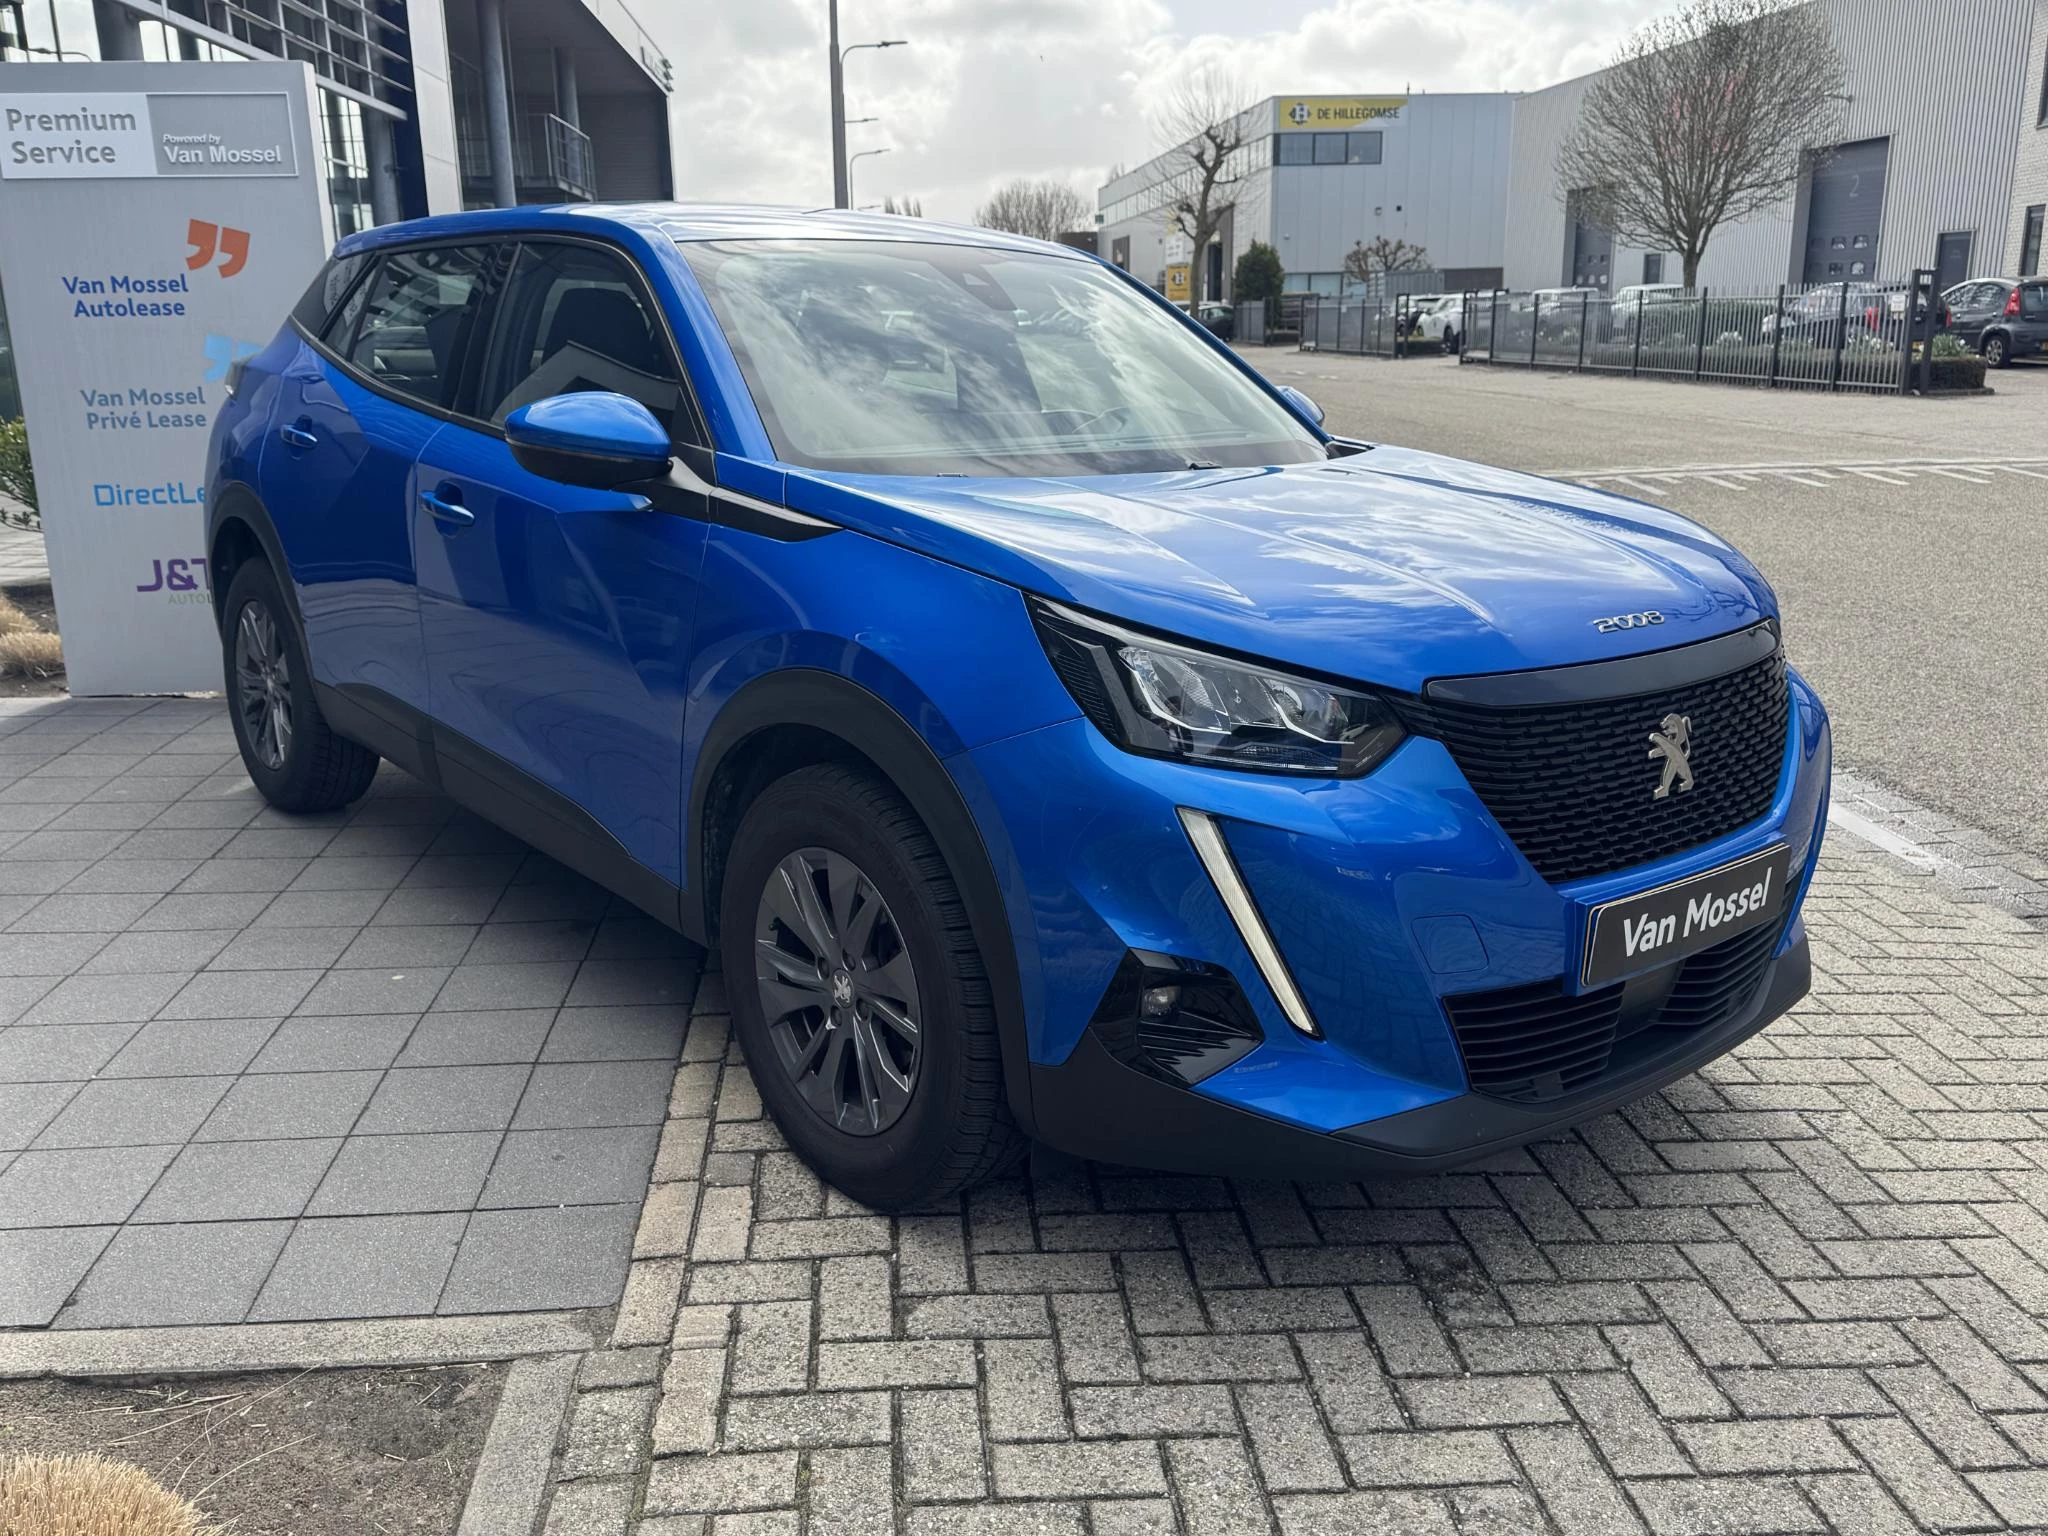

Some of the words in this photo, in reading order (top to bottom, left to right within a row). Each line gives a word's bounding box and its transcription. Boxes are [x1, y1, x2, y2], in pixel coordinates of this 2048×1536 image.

[5, 107, 137, 132] Premium
[1317, 107, 1332, 120] DE
[1334, 106, 1400, 119] HILLEGOMSE
[162, 134, 206, 144] Powered
[208, 134, 221, 145] by
[12, 139, 116, 165] Service
[163, 146, 204, 164] Van
[209, 145, 282, 164] Mossel
[62, 276, 105, 294] Van
[110, 273, 189, 293] Mossel
[74, 299, 186, 318] Autolease
[80, 389, 123, 407] Van
[128, 387, 206, 406] Mossel
[87, 411, 141, 430] Privé
[147, 411, 207, 428] Lease
[1593, 610, 1665, 633] 2008
[1623, 912, 1677, 957] Van
[1682, 866, 1773, 938] Mossel
